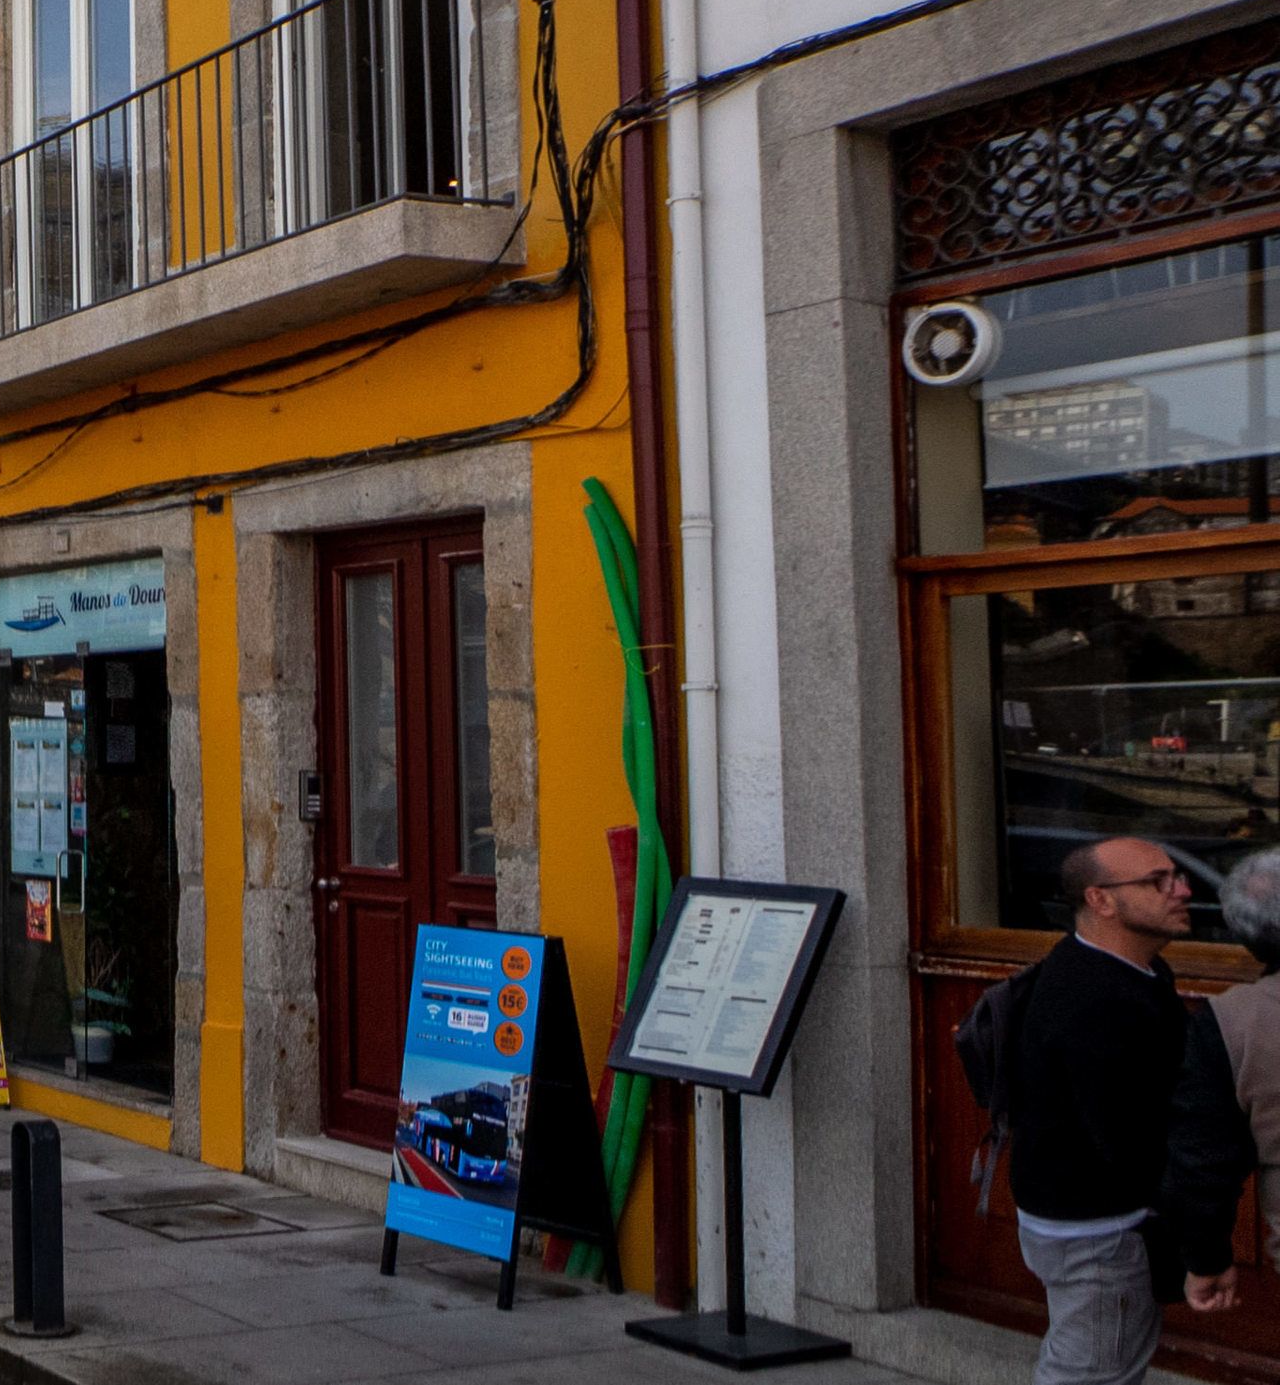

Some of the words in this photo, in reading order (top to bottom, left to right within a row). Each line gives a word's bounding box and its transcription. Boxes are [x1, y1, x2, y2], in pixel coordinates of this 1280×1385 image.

[69, 590, 111, 613] Manos
[128, 584, 167, 606] Dour
[425, 939, 448, 951] CITY
[424, 951, 494, 970] SIGHTSEEING
[452, 1011, 462, 1021] 16
